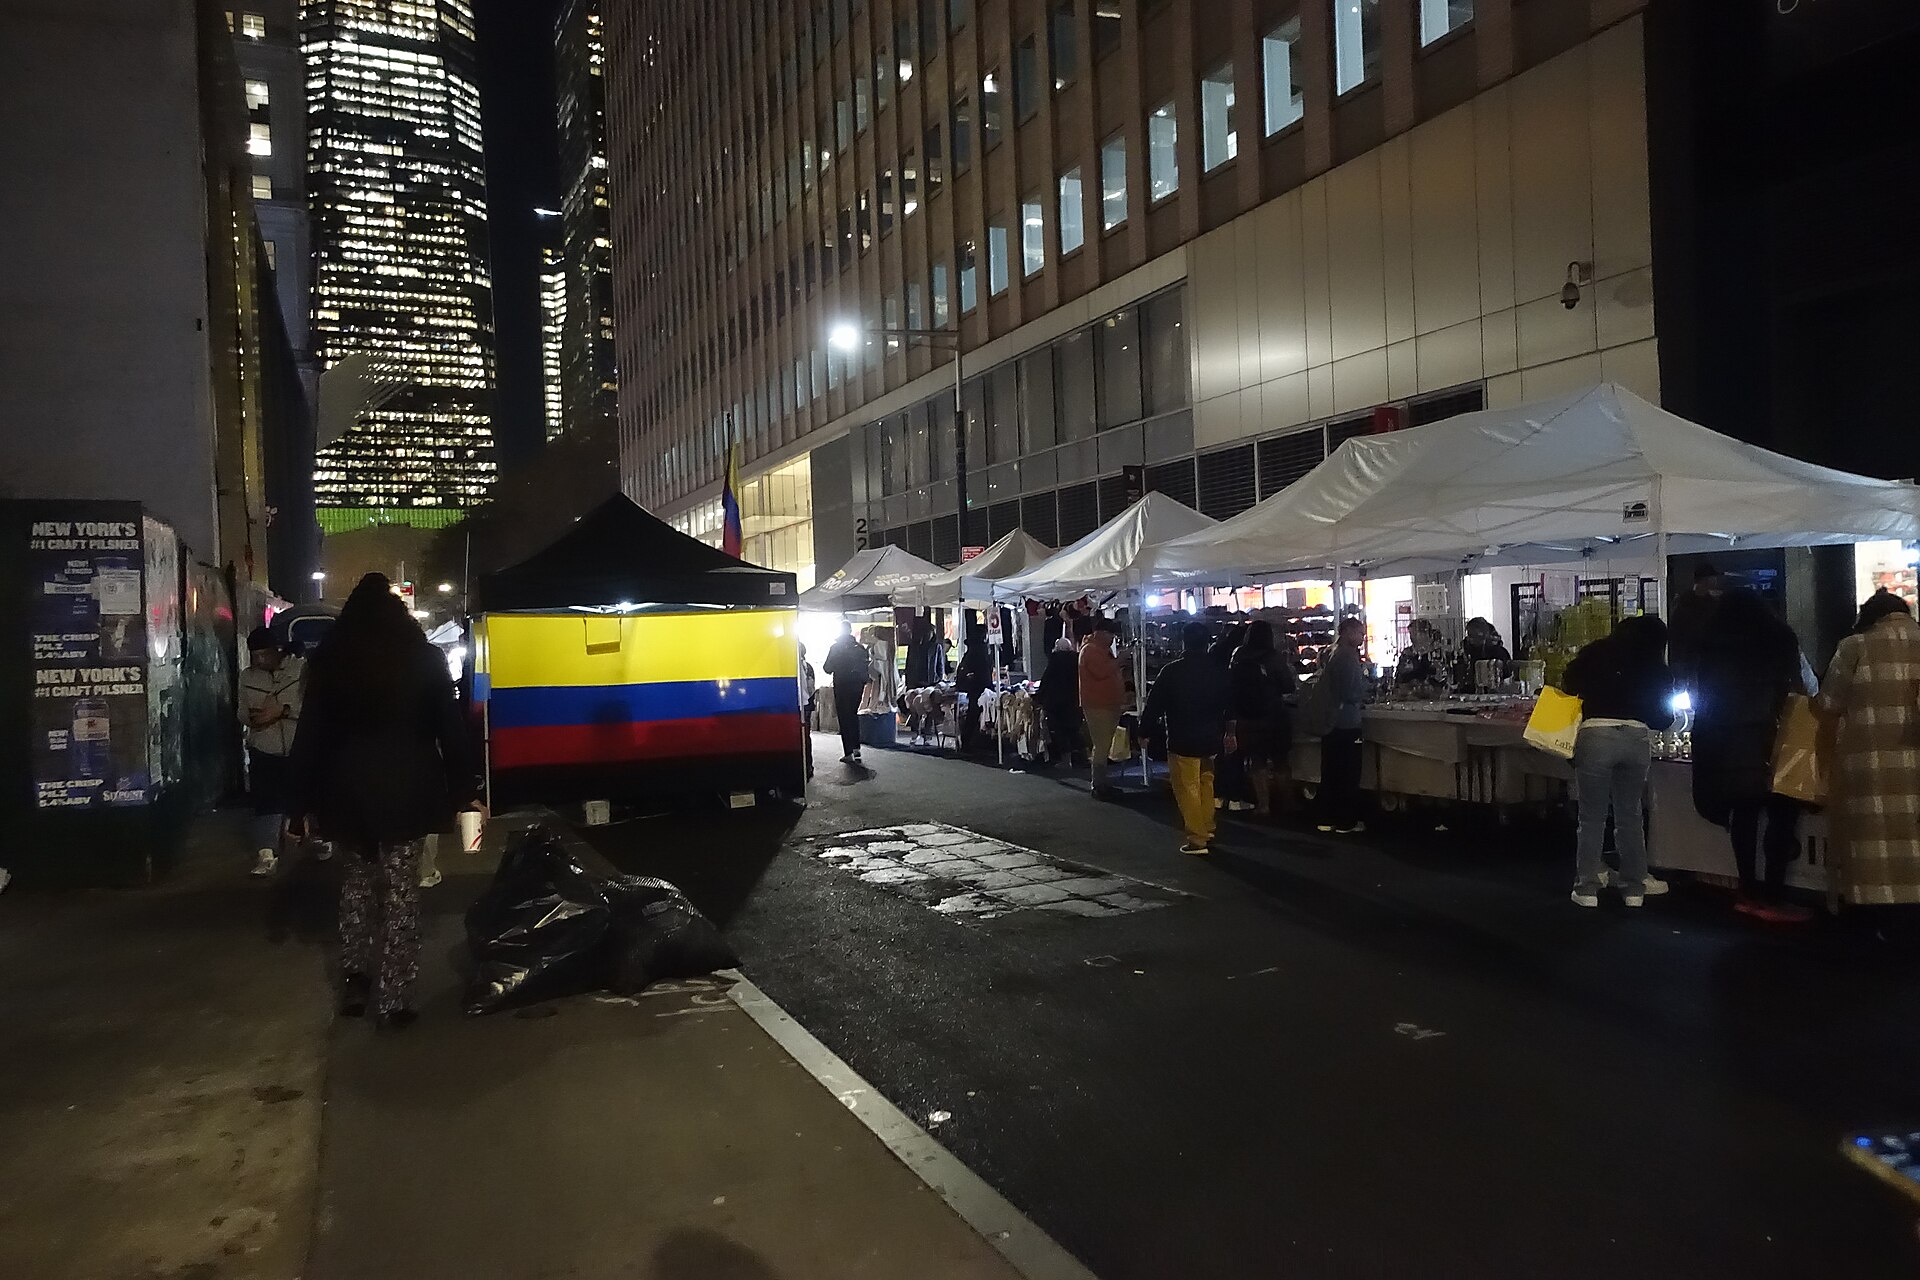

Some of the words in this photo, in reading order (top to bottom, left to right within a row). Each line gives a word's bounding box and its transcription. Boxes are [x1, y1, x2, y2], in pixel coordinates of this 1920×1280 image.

[32, 522, 71, 537] NEW
[74, 522, 137, 537] YORK'S
[30, 539, 45, 550] #1
[47, 539, 88, 550] CRAFT
[89, 539, 140, 550] PILSNER
[34, 634, 61, 642] THE
[61, 633, 99, 642] CRISP
[34, 643, 64, 651] PILZ
[36, 669, 76, 685] NEW
[79, 666, 142, 683] YORK'S
[34, 687, 50, 698] #1
[51, 685, 91, 697] CRAFT
[93, 683, 144, 696] PILSNER
[38, 781, 66, 790] THE
[65, 779, 104, 788] CRISP
[39, 789, 68, 799] PILZ
